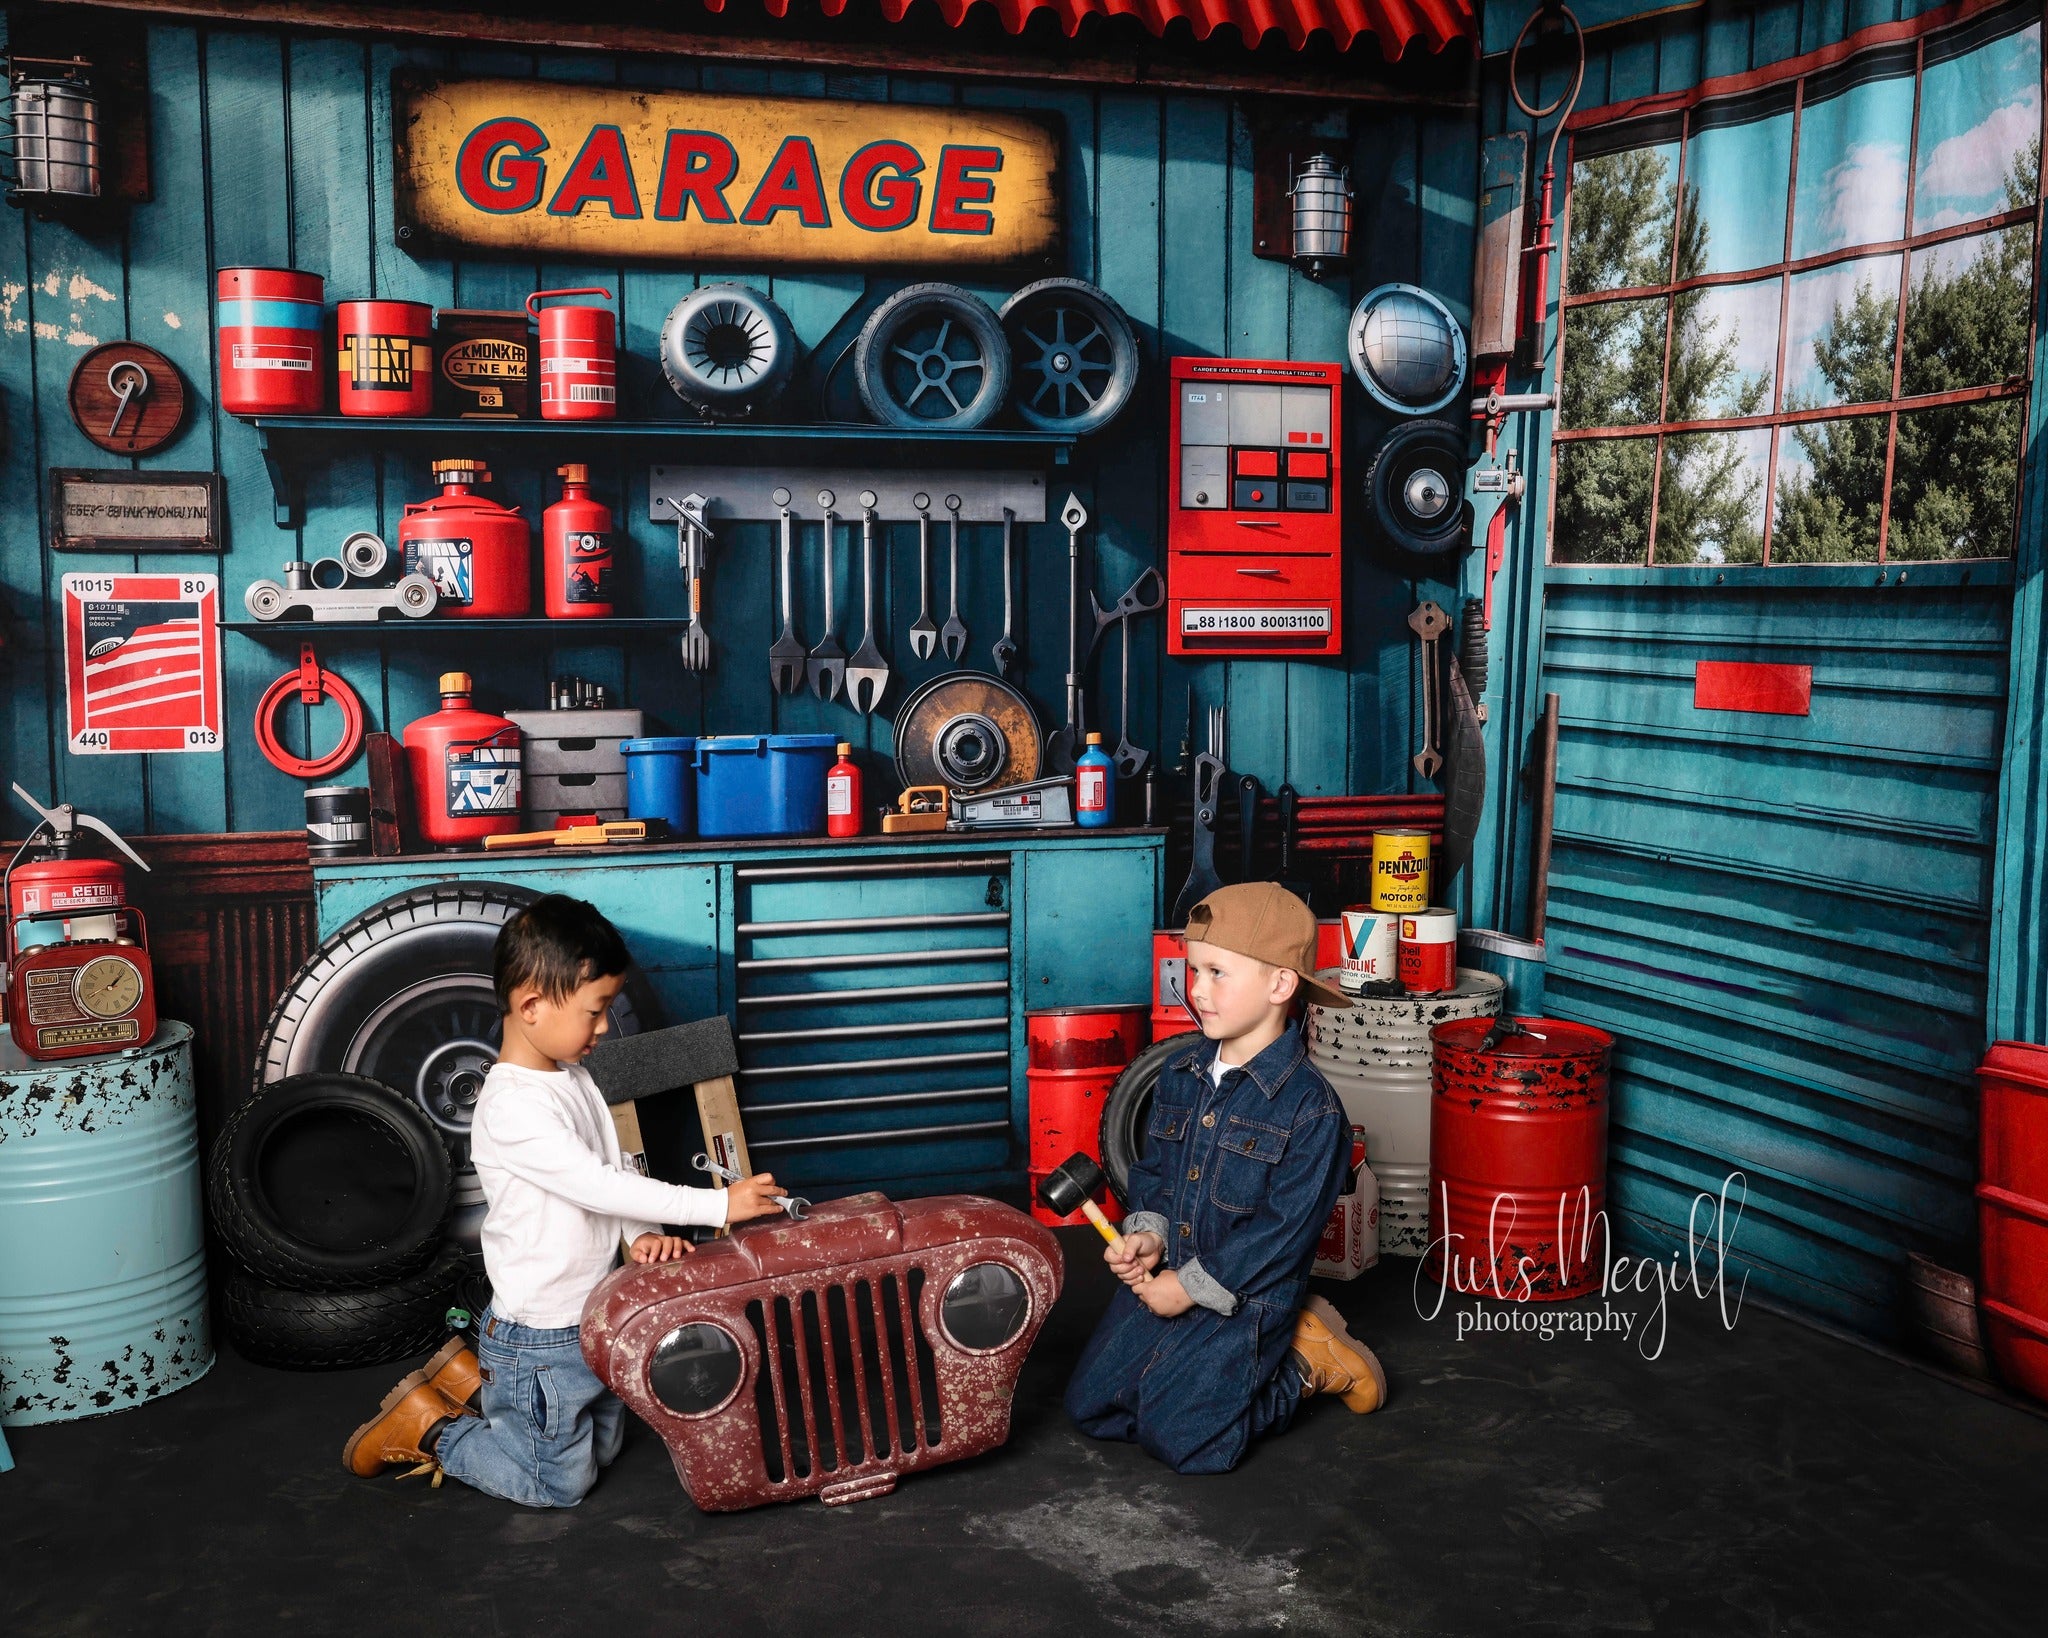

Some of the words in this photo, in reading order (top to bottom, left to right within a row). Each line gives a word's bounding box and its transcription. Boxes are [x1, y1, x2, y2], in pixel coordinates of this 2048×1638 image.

[455, 116, 1004, 235] GARAGE
[71, 579, 113, 592] 11015
[184, 580, 206, 593] 80
[1199, 616, 1216, 628] 88
[79, 732, 107, 746] 440
[189, 731, 217, 744] 013
[1378, 857, 1429, 874] PENNZOIL
[1380, 892, 1413, 902] MOTOR
[1416, 893, 1427, 902] OIL
[1400, 944, 1420, 956] Shell
[1341, 957, 1377, 974] ALVOLINE
[1350, 1200, 1362, 1270] Coca-Cola
